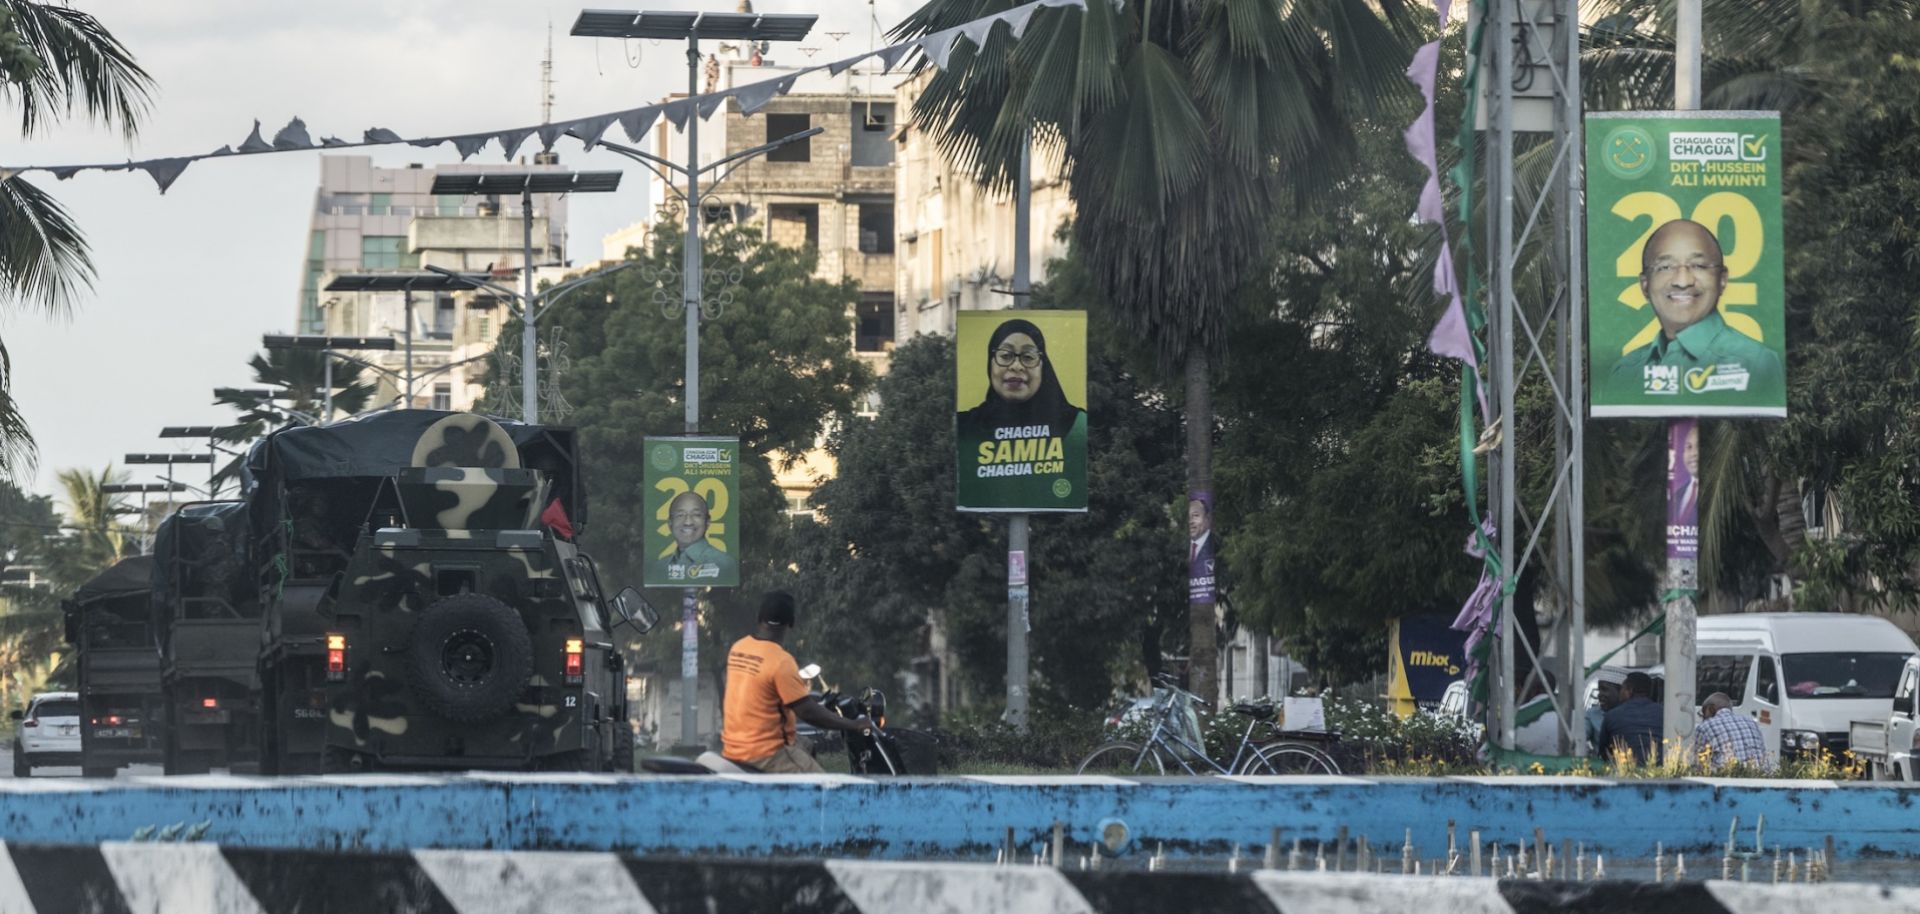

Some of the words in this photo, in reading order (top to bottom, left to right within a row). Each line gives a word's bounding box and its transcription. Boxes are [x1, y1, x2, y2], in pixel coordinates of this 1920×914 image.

[1674, 145, 1733, 155] CHAGUA
[1671, 174, 1698, 186] ALI
[1703, 174, 1766, 186] MWINYI
[995, 425, 1050, 439] CHAGUA
[978, 438, 1064, 463] SAMIA
[977, 464, 1032, 477] CHAGUA
[1034, 461, 1064, 473] CCM
[1409, 651, 1449, 666] mixx
[565, 696, 576, 707] 12
